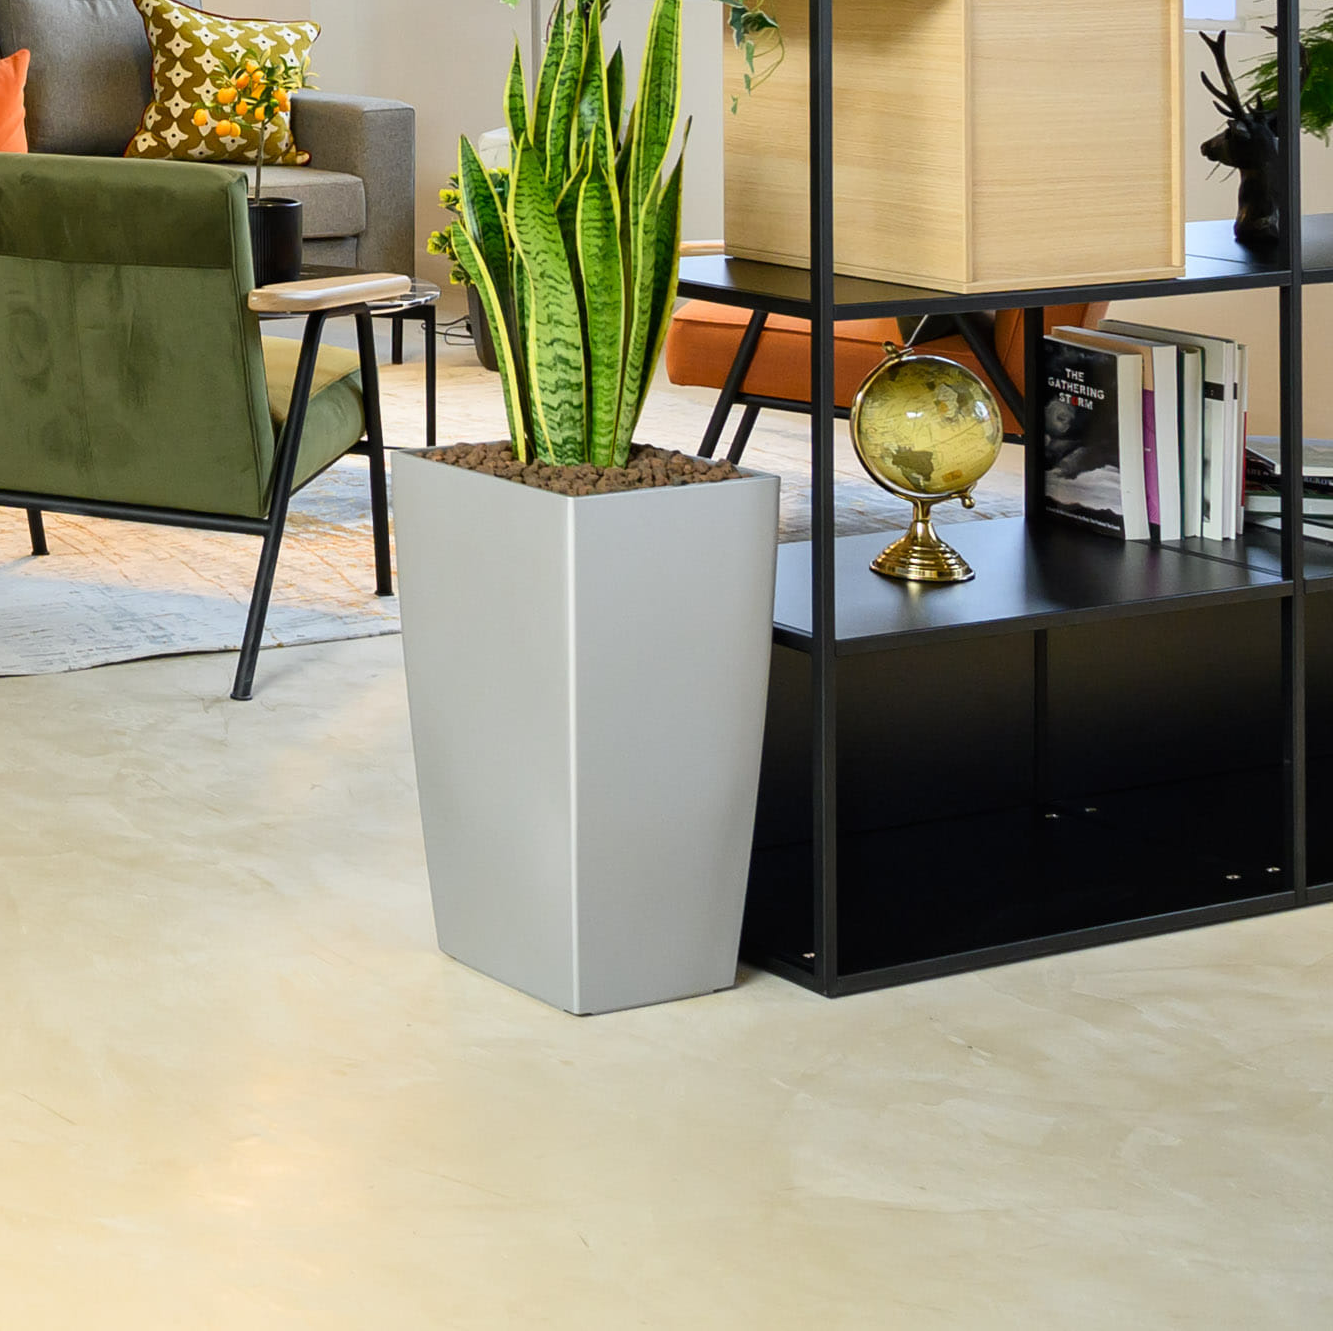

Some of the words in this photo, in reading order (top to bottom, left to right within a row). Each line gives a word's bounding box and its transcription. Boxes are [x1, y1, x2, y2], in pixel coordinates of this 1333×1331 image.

[1065, 367, 1085, 383] THE
[1047, 376, 1105, 400] GATHERING
[1058, 391, 1094, 411] STORM
